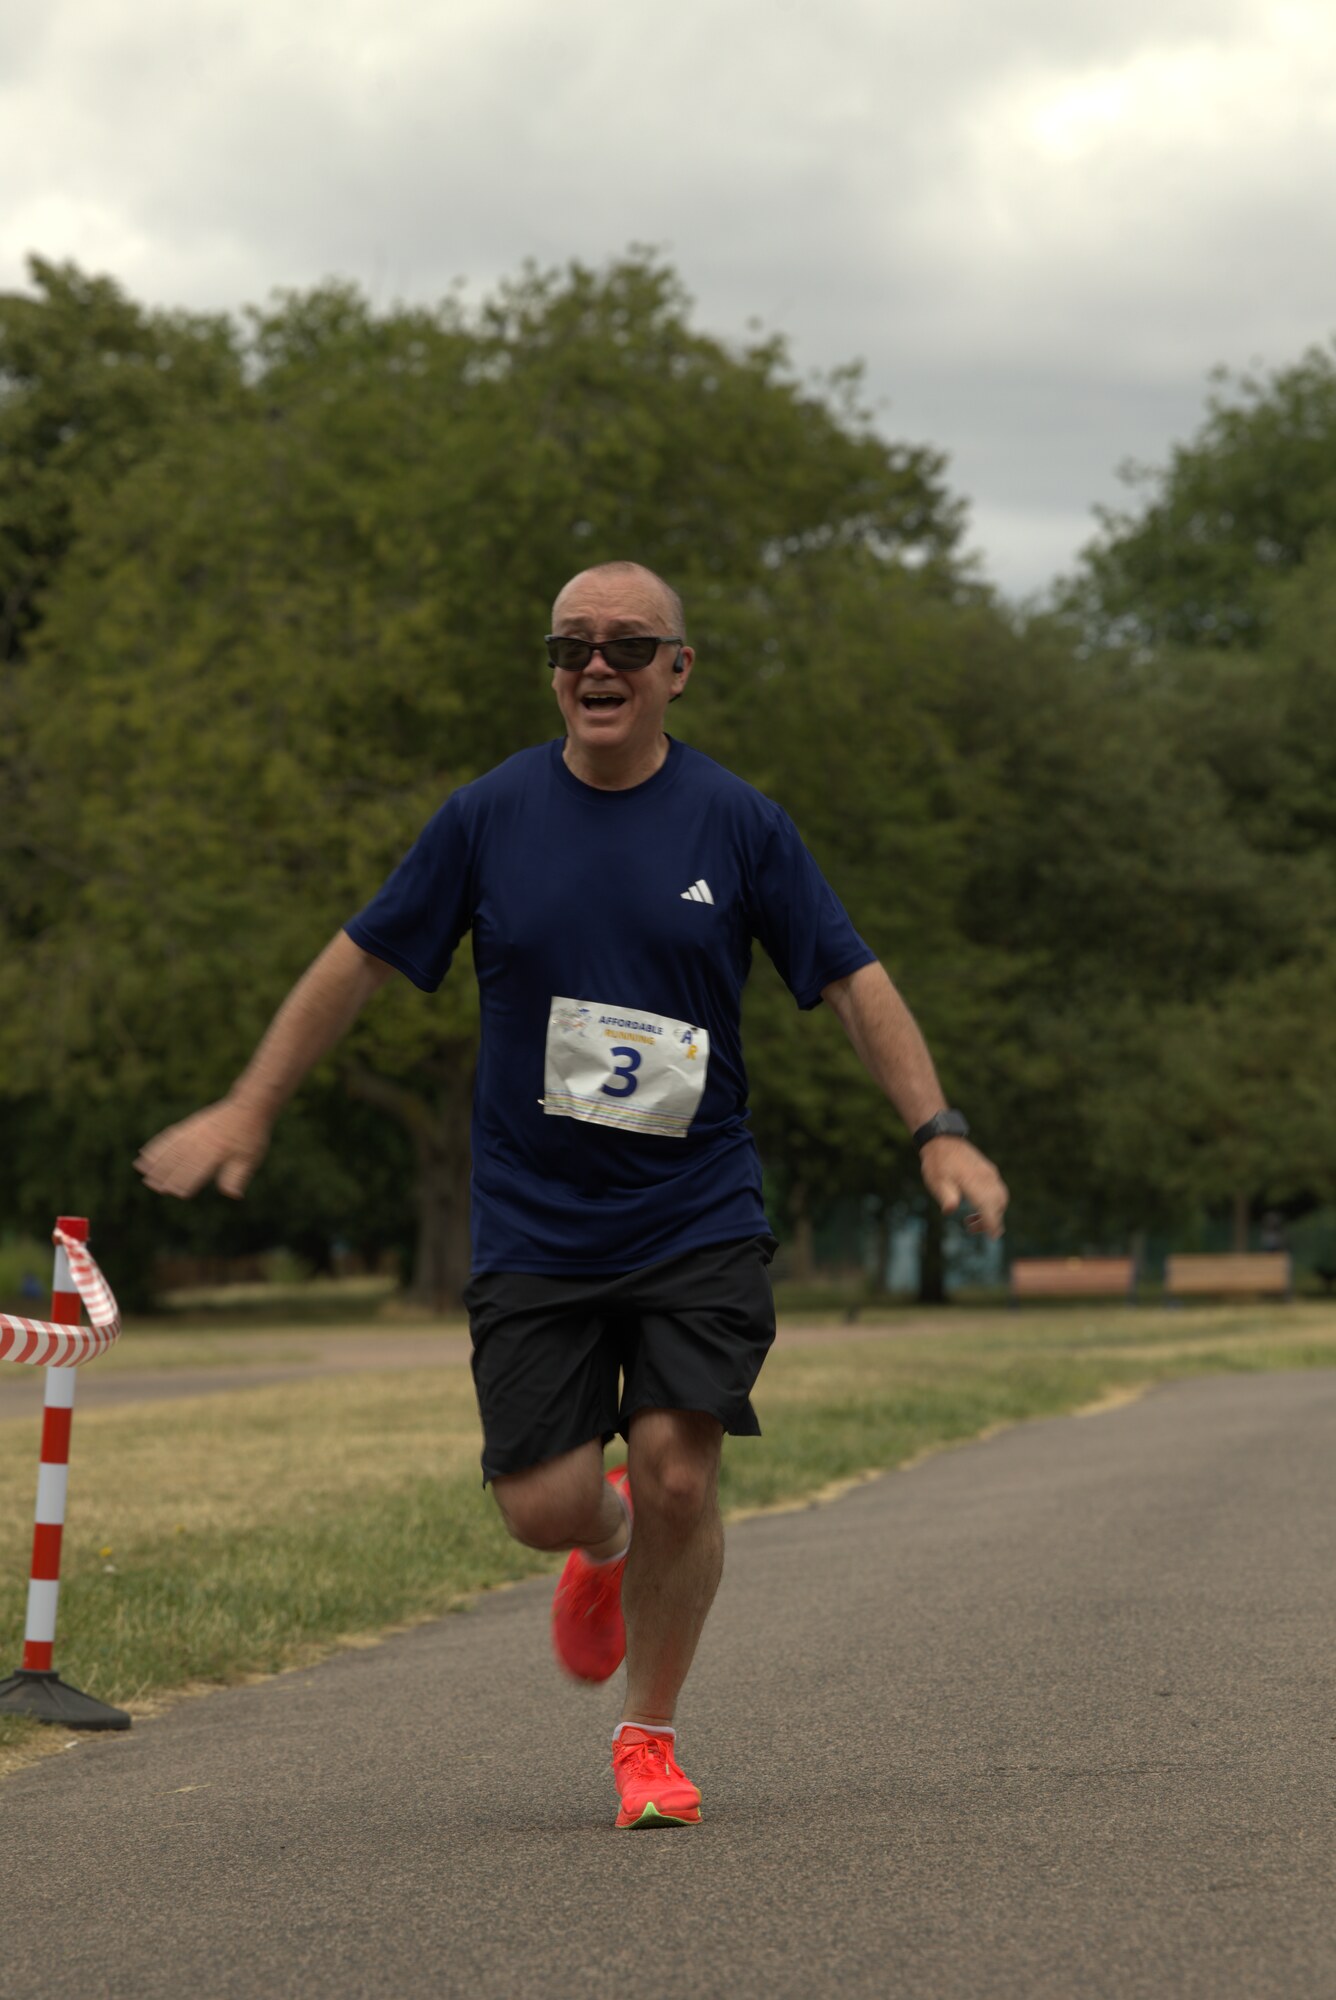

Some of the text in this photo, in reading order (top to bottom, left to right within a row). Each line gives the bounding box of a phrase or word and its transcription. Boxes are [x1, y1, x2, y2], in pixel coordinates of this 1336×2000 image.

[599, 1015, 663, 1035] AFFORDABLE
[604, 1029, 655, 1045] RUNNING
[680, 1030, 693, 1044] A
[600, 1046, 642, 1098] 3
